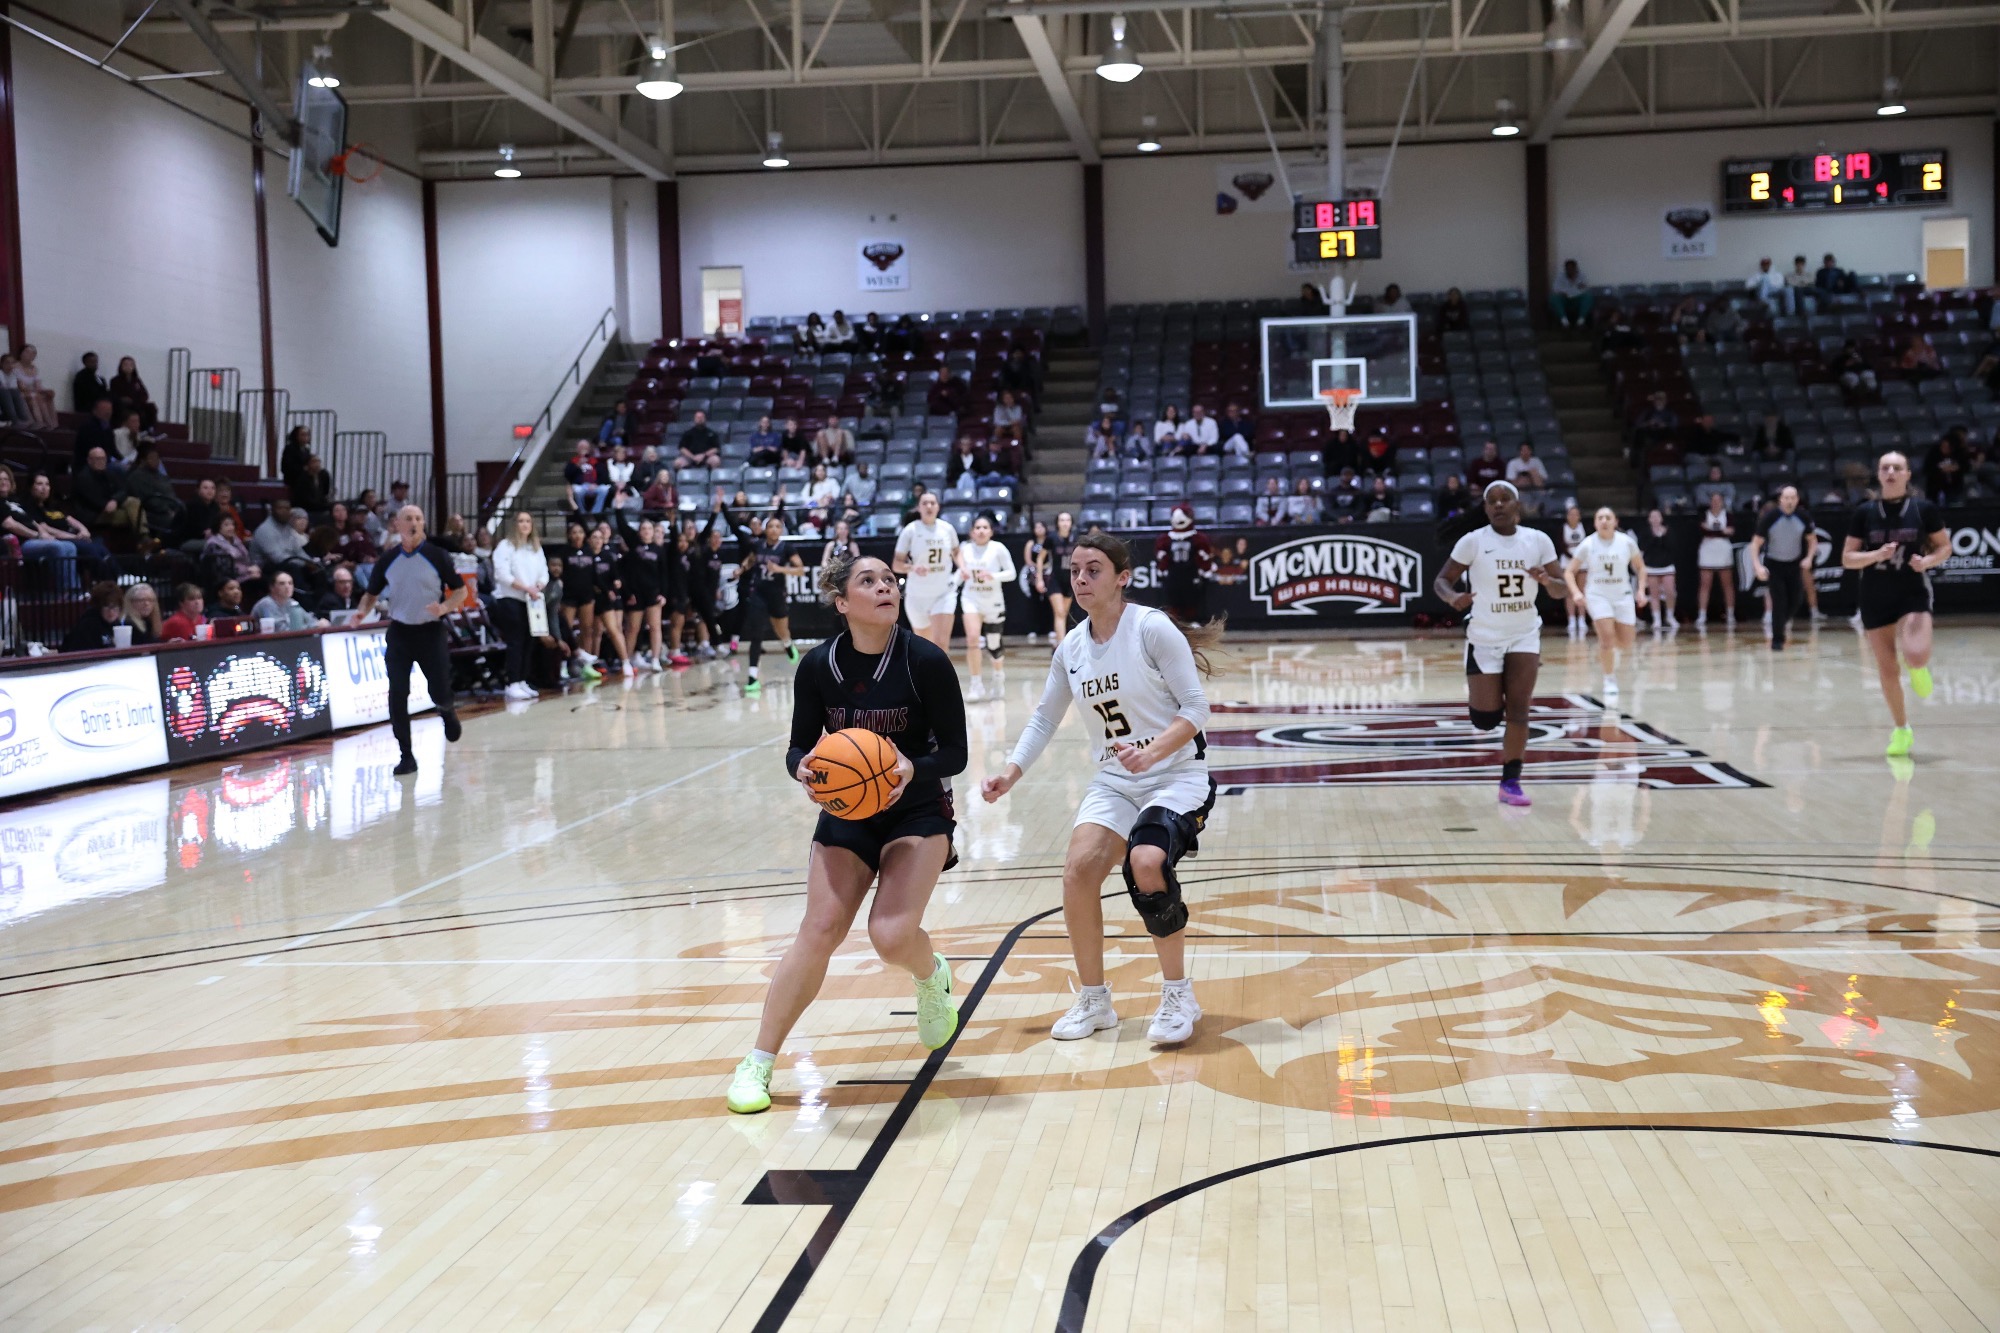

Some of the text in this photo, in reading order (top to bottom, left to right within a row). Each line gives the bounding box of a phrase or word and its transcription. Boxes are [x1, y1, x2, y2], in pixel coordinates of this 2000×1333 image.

[1814, 152, 1871, 182] 8:19
[1923, 163, 1942, 191] 2
[1750, 172, 1770, 201] 2
[1316, 201, 1375, 228] 8:19
[1320, 231, 1356, 258] 27
[928, 548, 943, 564] 21
[1495, 559, 1526, 570] TEXAS
[1603, 562, 1613, 577] 4
[1277, 578, 1395, 602] WAR HAWKS
[1497, 574, 1525, 598] 23
[1081, 672, 1120, 699] TEXAS
[80, 709, 112, 735] Bone
[126, 701, 156, 727] Joint
[852, 706, 909, 734] HAWKS
[1092, 698, 1132, 740] 15
